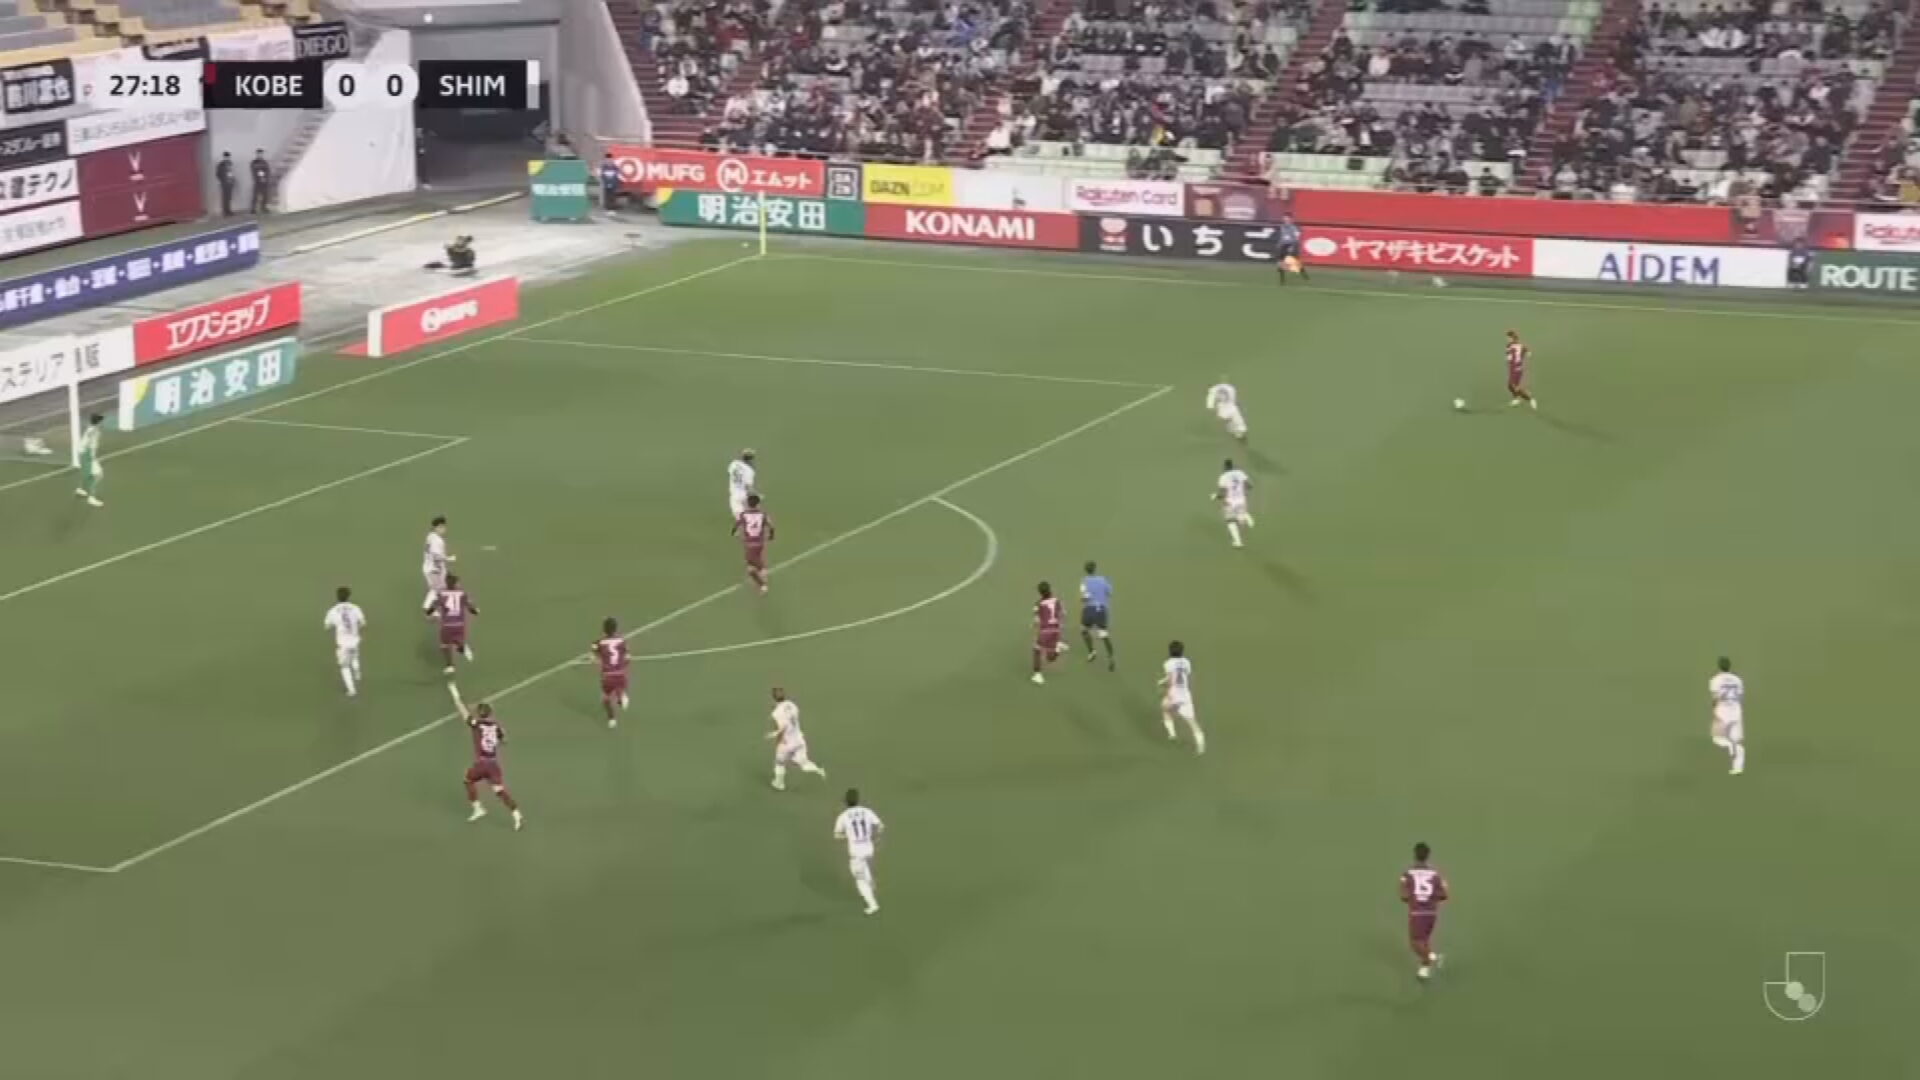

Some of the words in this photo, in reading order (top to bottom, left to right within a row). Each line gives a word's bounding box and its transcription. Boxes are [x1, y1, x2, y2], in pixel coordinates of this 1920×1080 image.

[647, 162, 705, 182] MUFG
[751, 171, 812, 189] エムット
[1143, 189, 1177, 205] Card
[698, 194, 825, 230] 明治安田
[905, 209, 1035, 241] KONAMI
[1143, 223, 1275, 259] いちご
[1342, 236, 1520, 269] ヤマザキビスケット
[1820, 264, 1919, 291] ROUTE
[166, 294, 271, 351] エクスショップ
[154, 348, 282, 415] 明治安田
[851, 819, 867, 838] 11
[1414, 876, 1434, 896] 15
